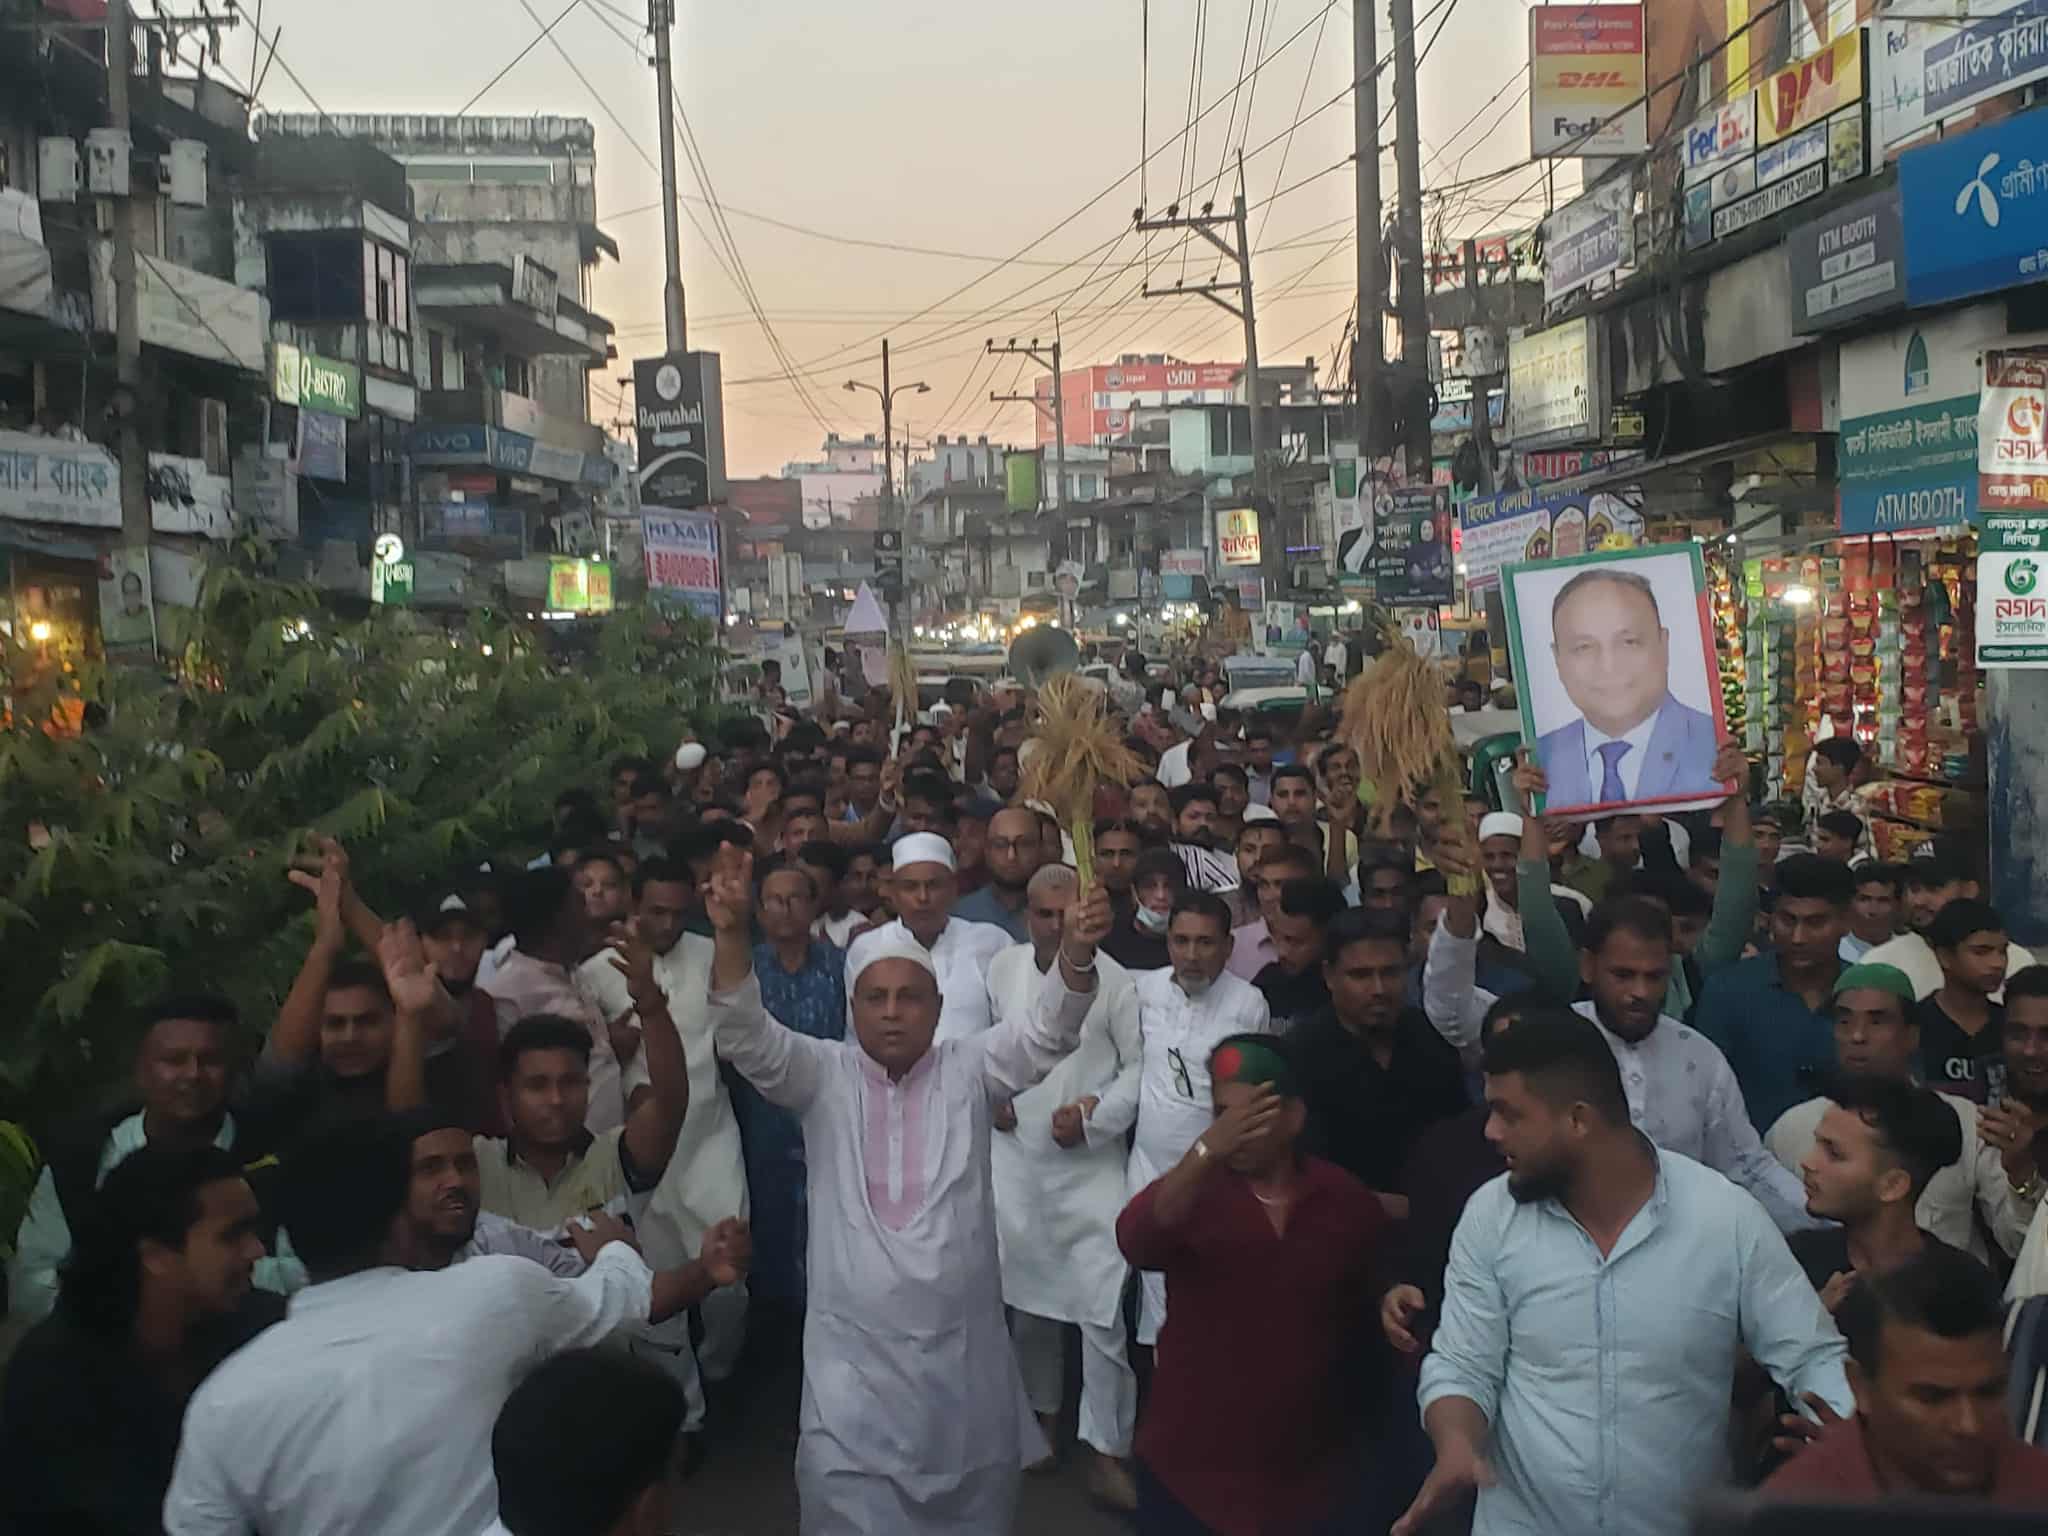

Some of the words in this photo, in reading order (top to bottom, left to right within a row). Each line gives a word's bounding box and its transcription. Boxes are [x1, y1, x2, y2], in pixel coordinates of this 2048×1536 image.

[1557, 72, 1626, 88] DHL
[1818, 229, 1841, 256] ATM
[1842, 215, 1877, 246] BOOTH
[301, 355, 347, 404] Q-BISTRO
[638, 401, 703, 432] Rajmahal
[1875, 493, 1906, 525] ATM
[1909, 486, 1966, 521] BOOTH
[1995, 598, 2047, 619] নগদ
